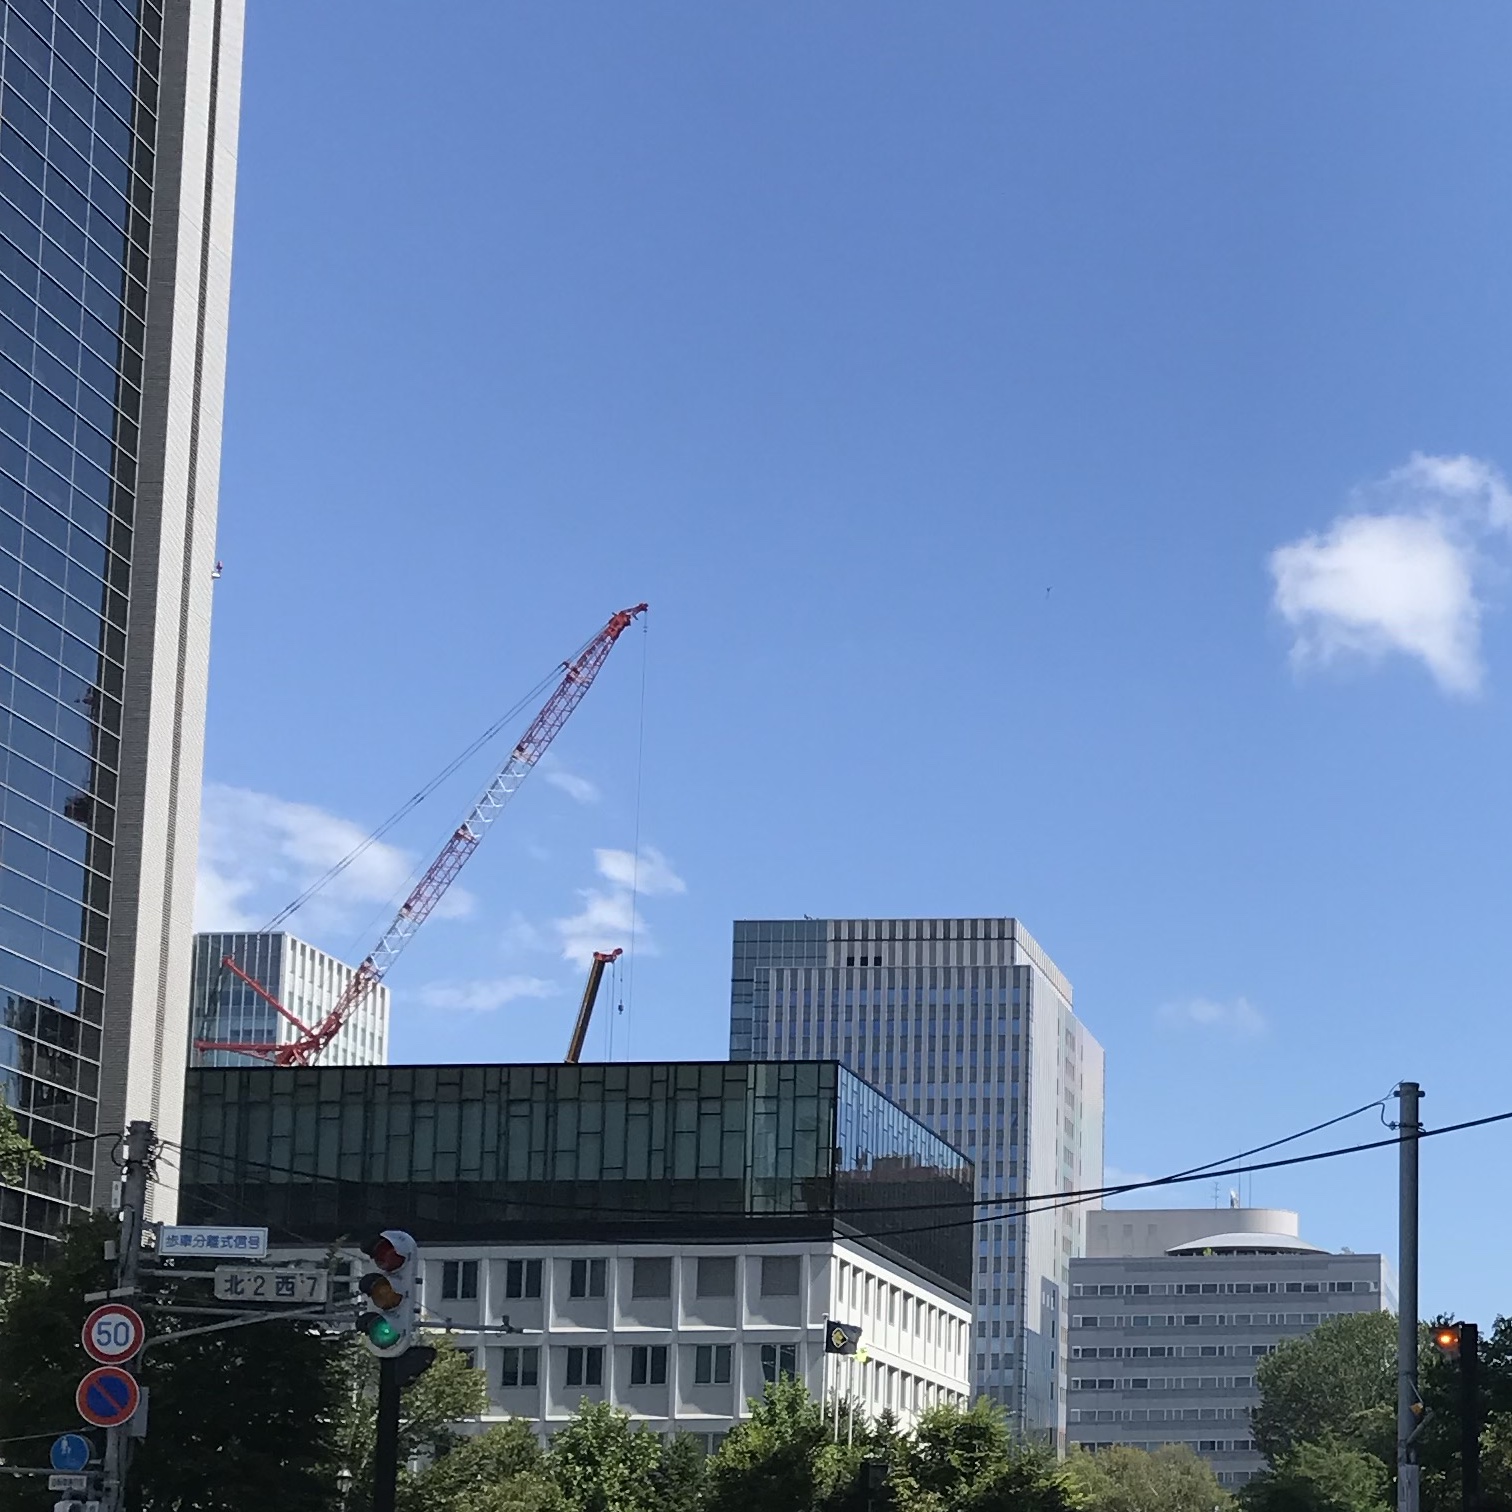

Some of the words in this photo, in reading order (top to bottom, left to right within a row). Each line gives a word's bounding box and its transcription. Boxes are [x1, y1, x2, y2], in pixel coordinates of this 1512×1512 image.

[166, 1234, 260, 1250] 歩車分離式信号
[96, 1321, 130, 1347] 50
